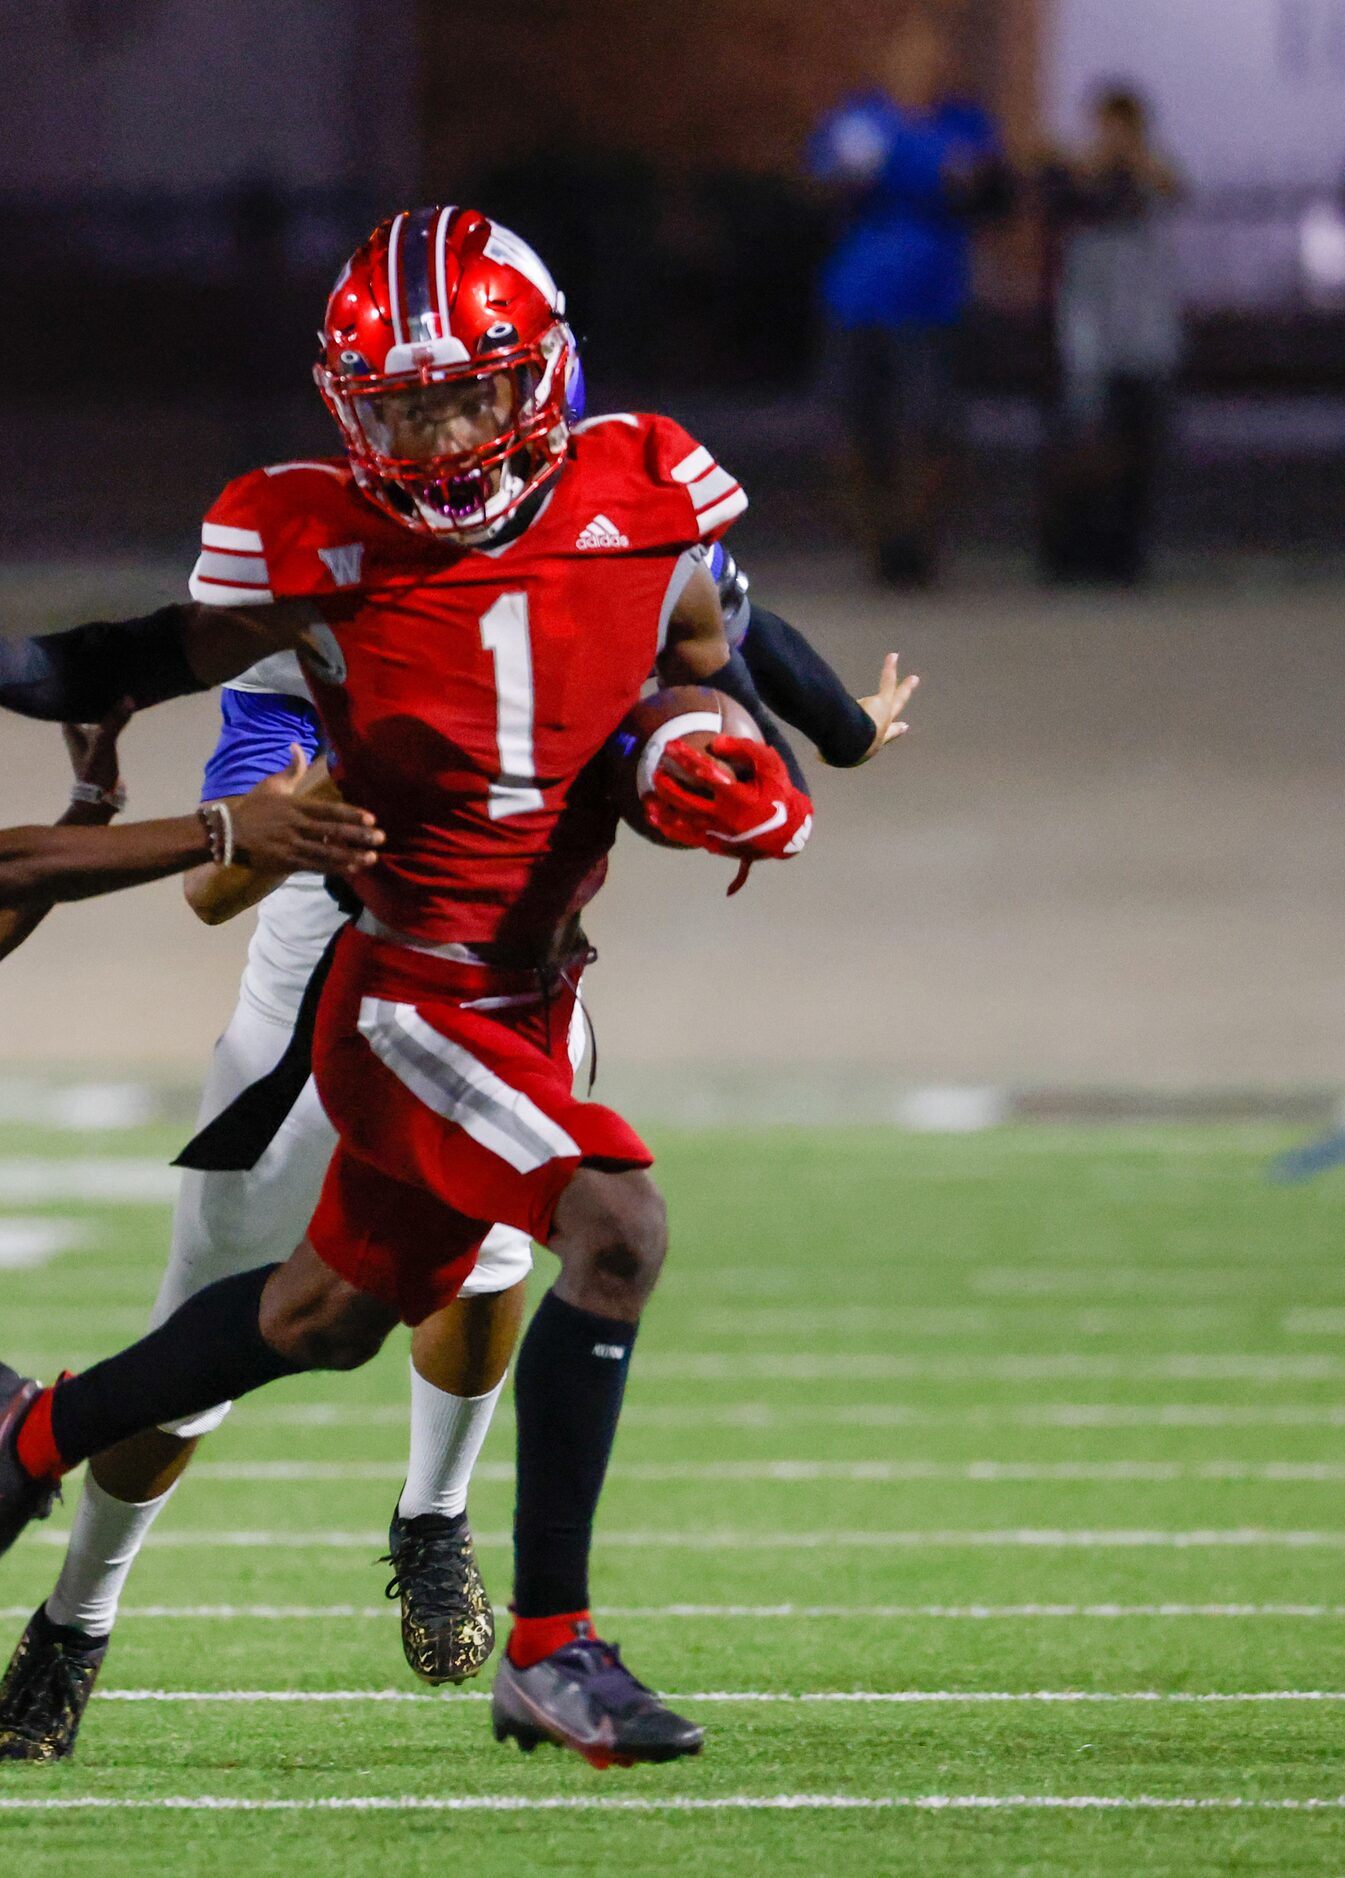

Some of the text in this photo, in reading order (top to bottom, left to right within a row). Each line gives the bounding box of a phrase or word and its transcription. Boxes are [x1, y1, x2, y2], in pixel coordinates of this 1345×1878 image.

[575, 534, 630, 551] adidas
[317, 543, 364, 587] W
[479, 591, 544, 820] 1
